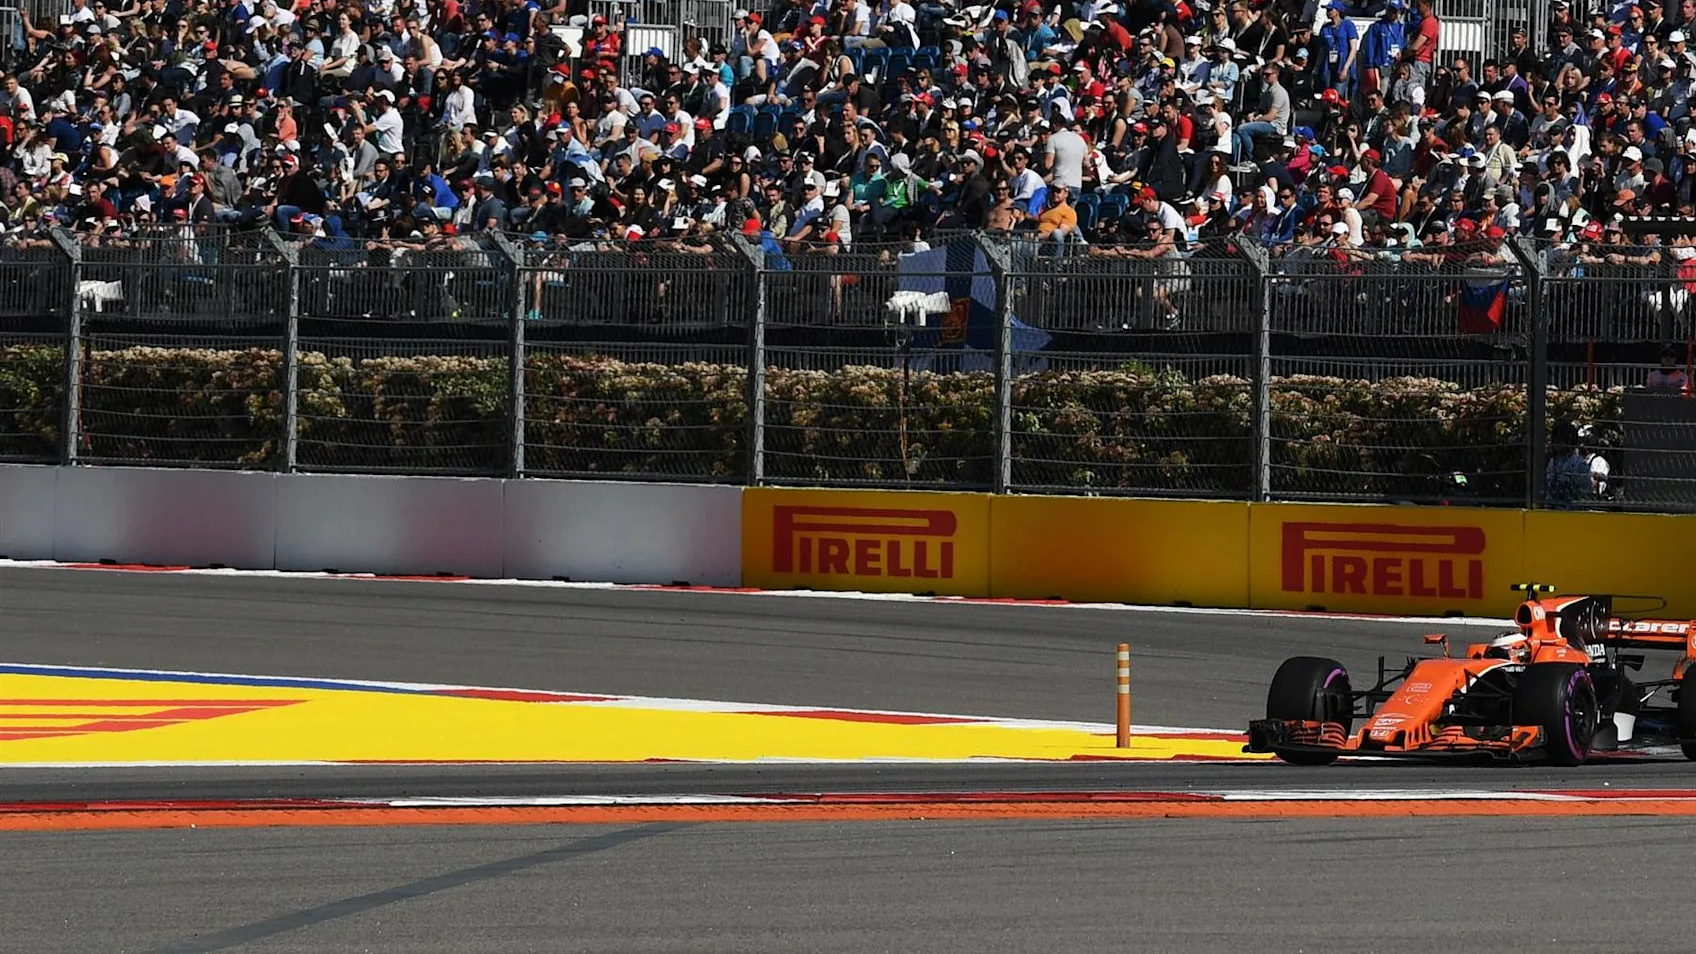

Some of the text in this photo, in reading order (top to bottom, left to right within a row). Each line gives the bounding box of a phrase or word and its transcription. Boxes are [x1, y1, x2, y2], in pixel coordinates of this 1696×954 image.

[773, 505, 957, 579] PIRELLI
[1282, 521, 1486, 600] PIRELLI
[1608, 620, 1690, 634] cLaren
